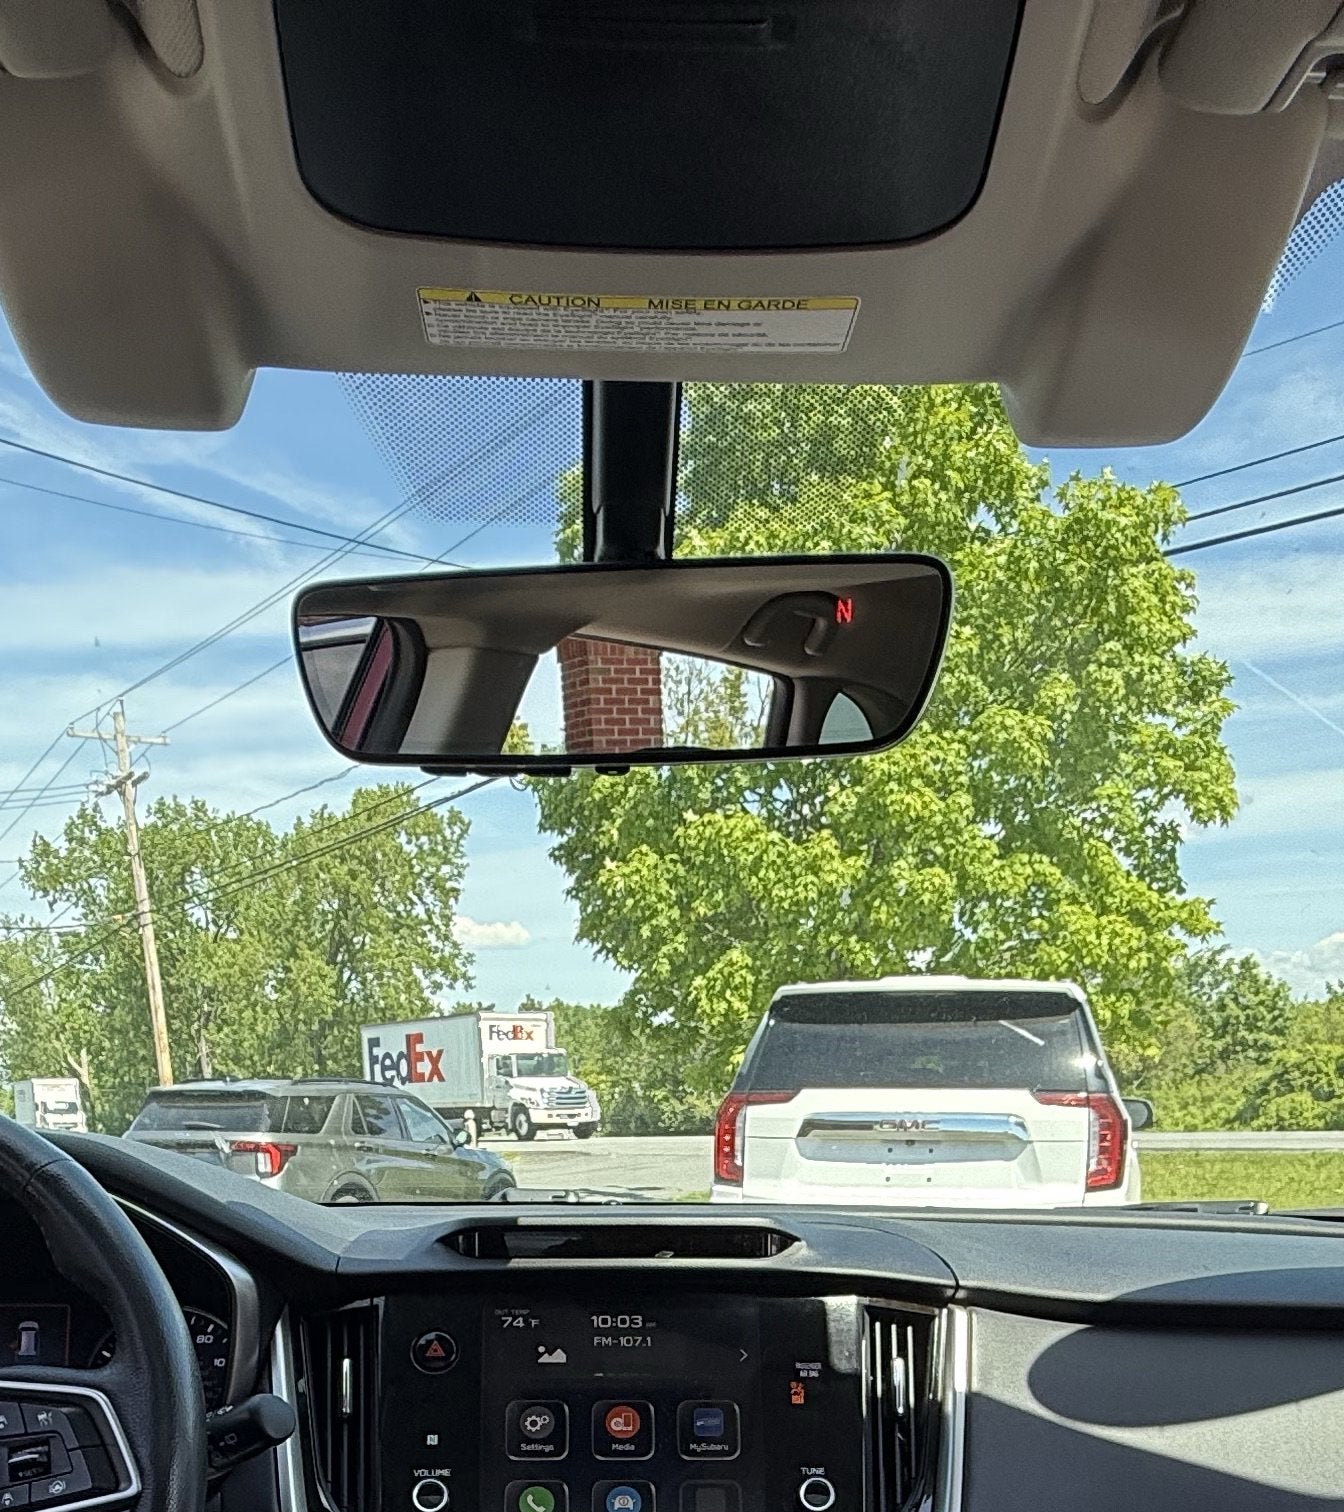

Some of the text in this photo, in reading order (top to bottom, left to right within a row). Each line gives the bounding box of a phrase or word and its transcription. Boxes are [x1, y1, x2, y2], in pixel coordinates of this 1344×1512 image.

[508, 293, 811, 311] CAUTION MISE EN GARDE
[837, 598, 852, 624] N
[489, 1024, 535, 1041] FedEx
[367, 1032, 446, 1087] FedEx
[879, 1119, 941, 1132] GMC
[501, 1316, 525, 1328] 74
[590, 1314, 644, 1328] 10:03
[195, 1334, 214, 1344] 80
[592, 1335, 653, 1347] FM-107.1
[520, 1443, 555, 1453] Settings
[611, 1443, 636, 1451] Media
[689, 1443, 729, 1453] MySubaru
[413, 1468, 452, 1478] VOLUME
[800, 1467, 826, 1476] TUNE
